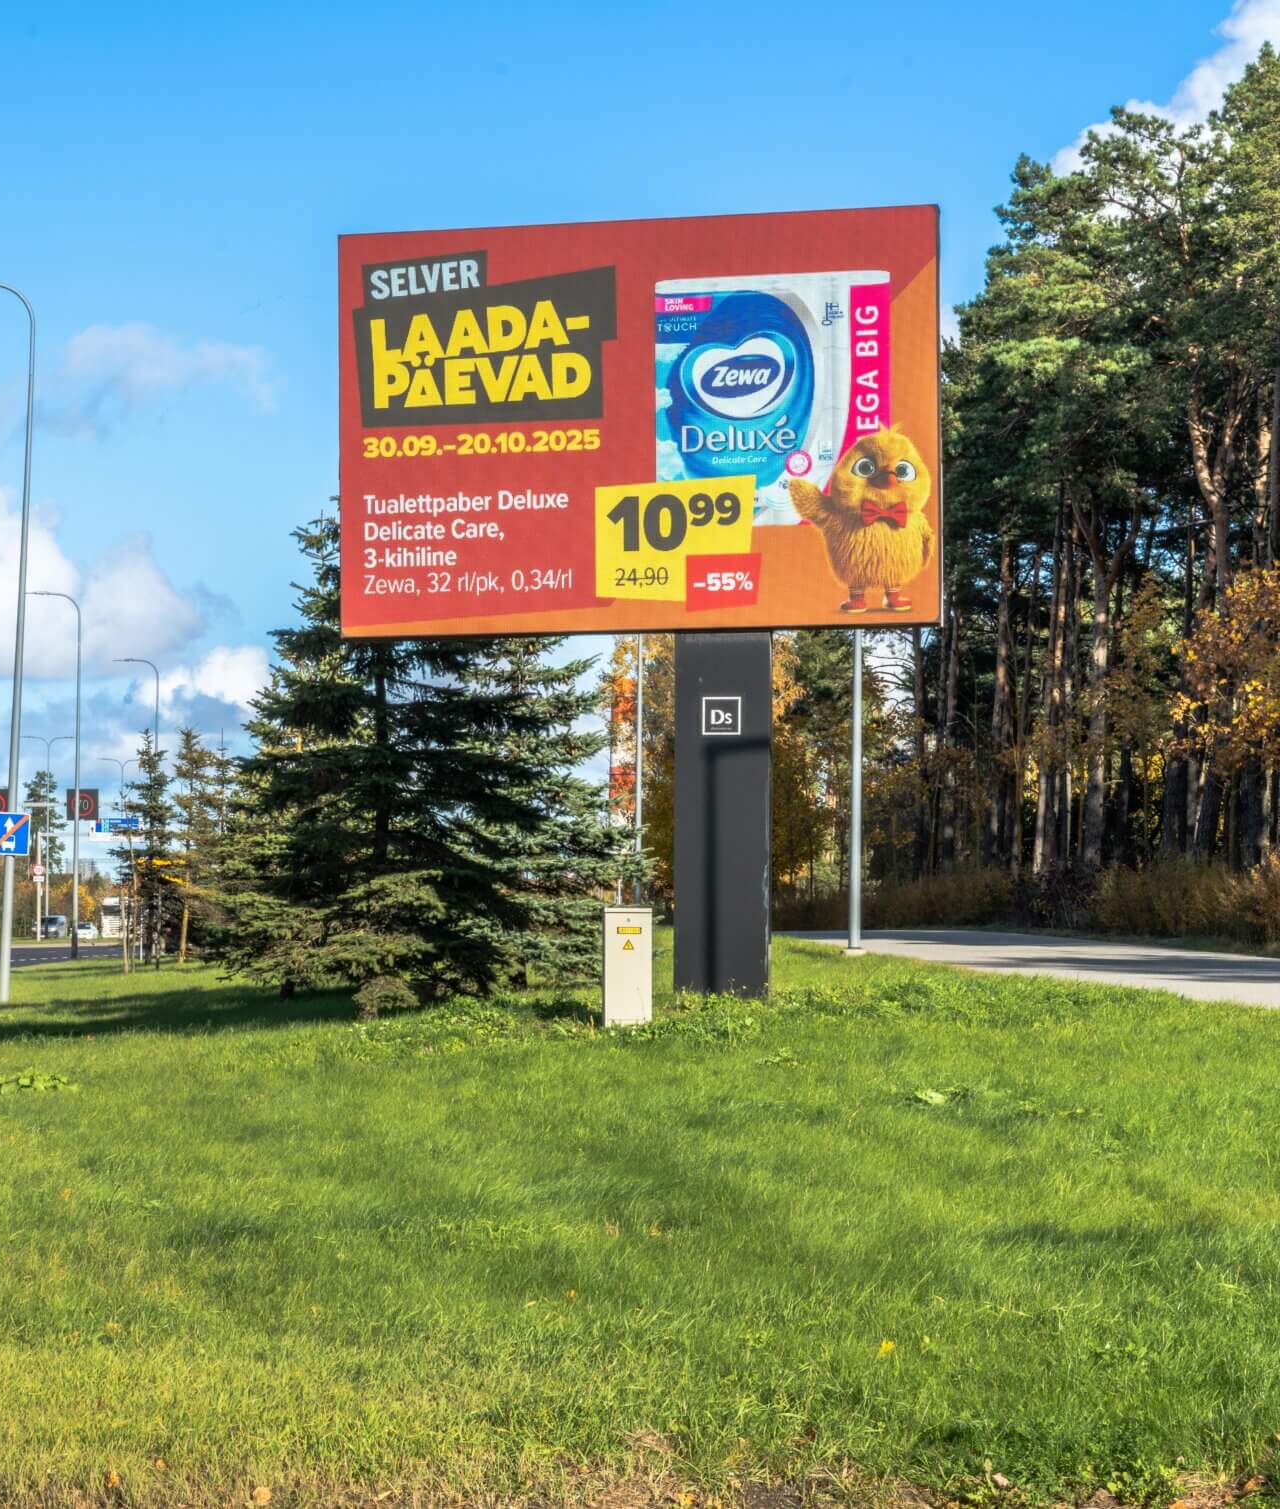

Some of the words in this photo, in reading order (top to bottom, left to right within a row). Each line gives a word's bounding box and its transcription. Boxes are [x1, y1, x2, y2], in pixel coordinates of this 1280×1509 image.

[371, 259, 480, 300] SELVER
[370, 300, 590, 363] LAADA-
[855, 305, 879, 357] BIG
[372, 352, 592, 409] PÄEVAD
[711, 366, 772, 387] Zewa
[856, 369, 880, 442] EGA
[712, 457, 746, 465] Delicate
[364, 491, 492, 517] Tualettpaber
[497, 489, 569, 510] Deluxe
[364, 520, 445, 541] Delicate
[451, 518, 505, 540] Care,
[364, 546, 457, 568] 3-kihiline
[364, 574, 421, 596] Zewa,
[427, 571, 452, 592] 32
[511, 568, 573, 592] 0,34/rl
[711, 709, 733, 725] Ds
